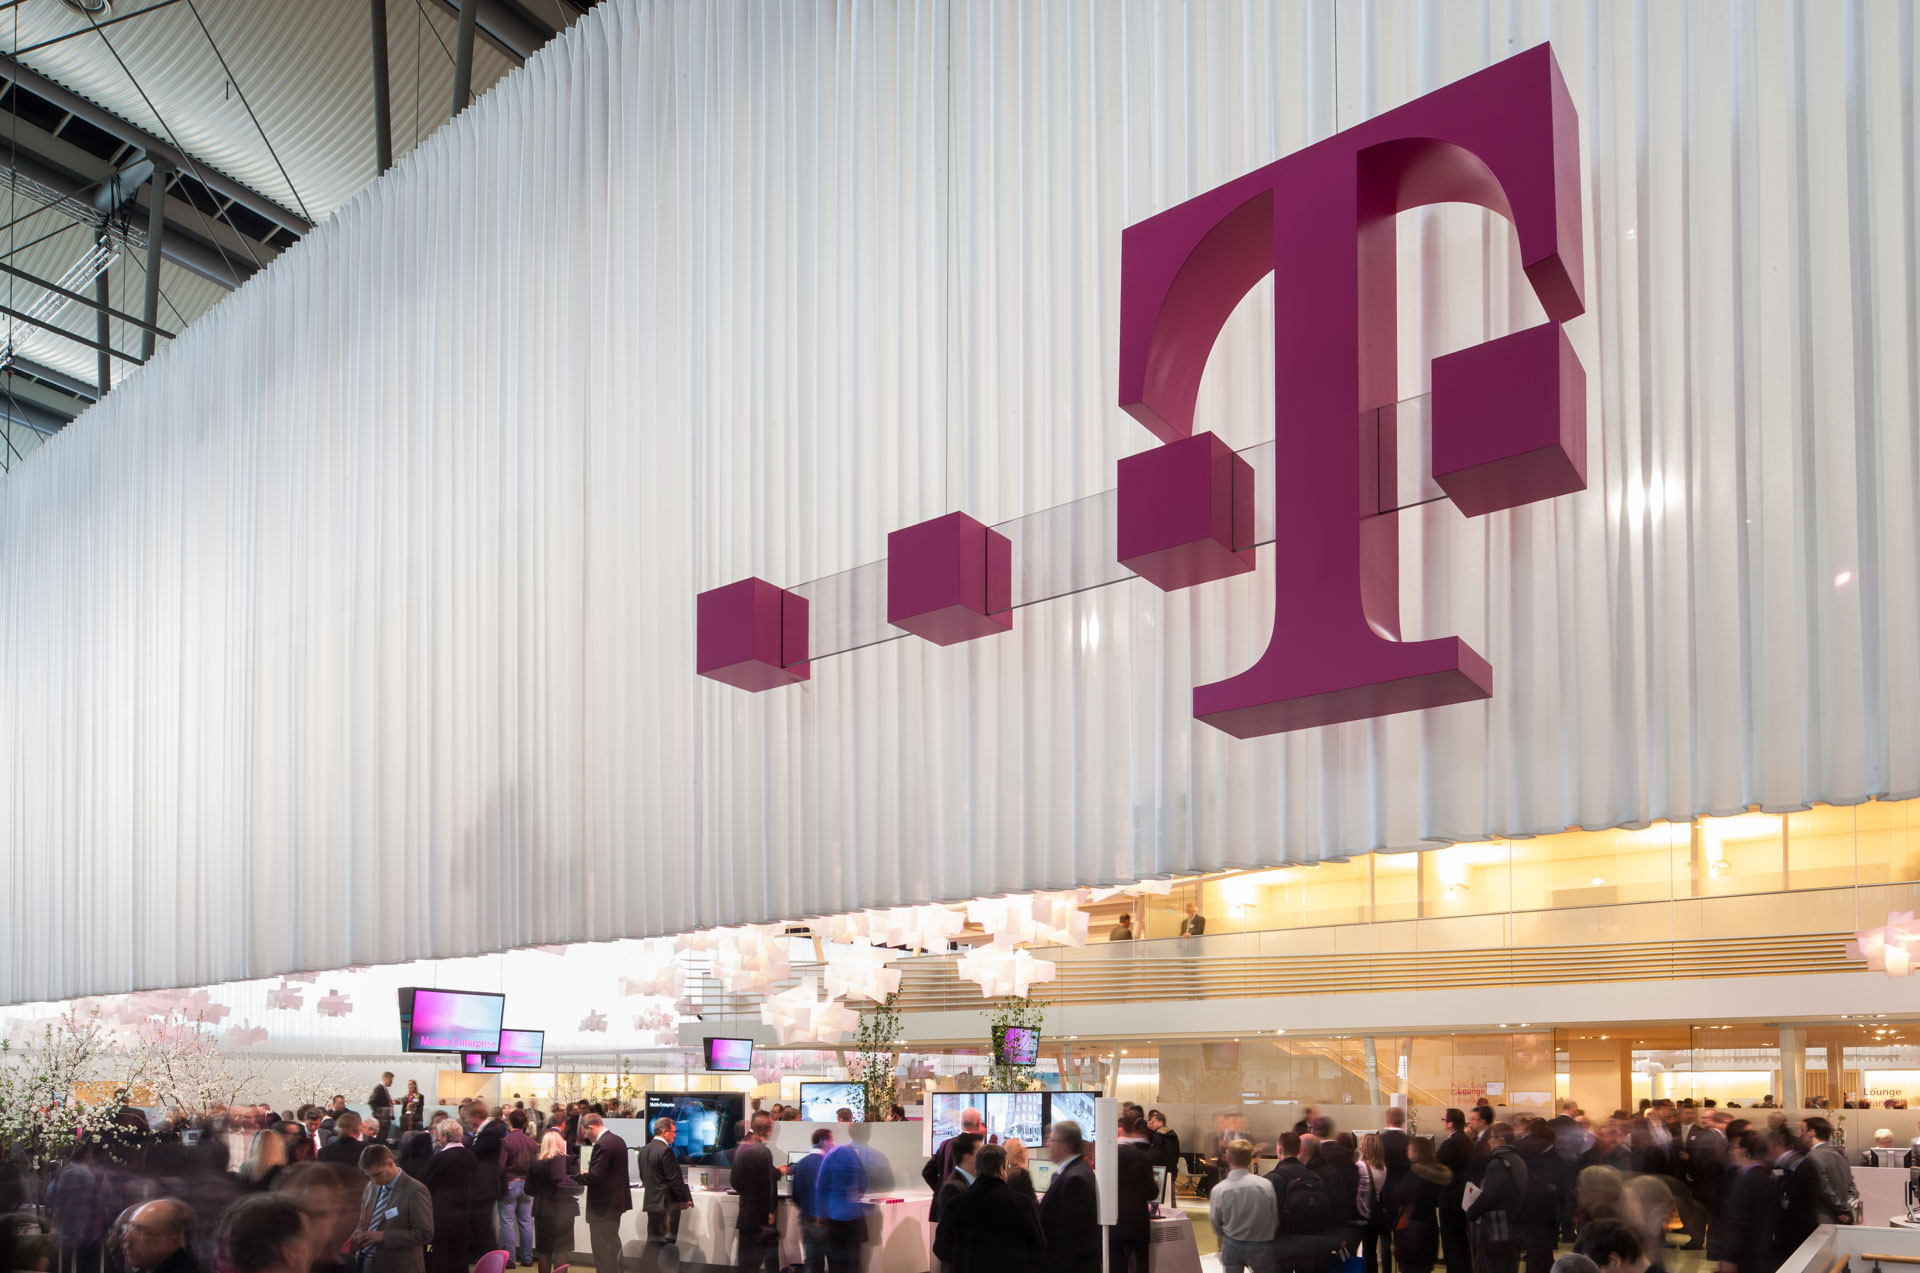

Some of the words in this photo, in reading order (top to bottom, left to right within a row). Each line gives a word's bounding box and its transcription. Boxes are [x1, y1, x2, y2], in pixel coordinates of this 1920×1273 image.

[1119, 42, 1584, 738] T
[420, 1035, 451, 1047] Mobile
[453, 1037, 496, 1049] Enterprise
[1458, 1088, 1486, 1096] Lounge
[1863, 1087, 1902, 1098] Lounge
